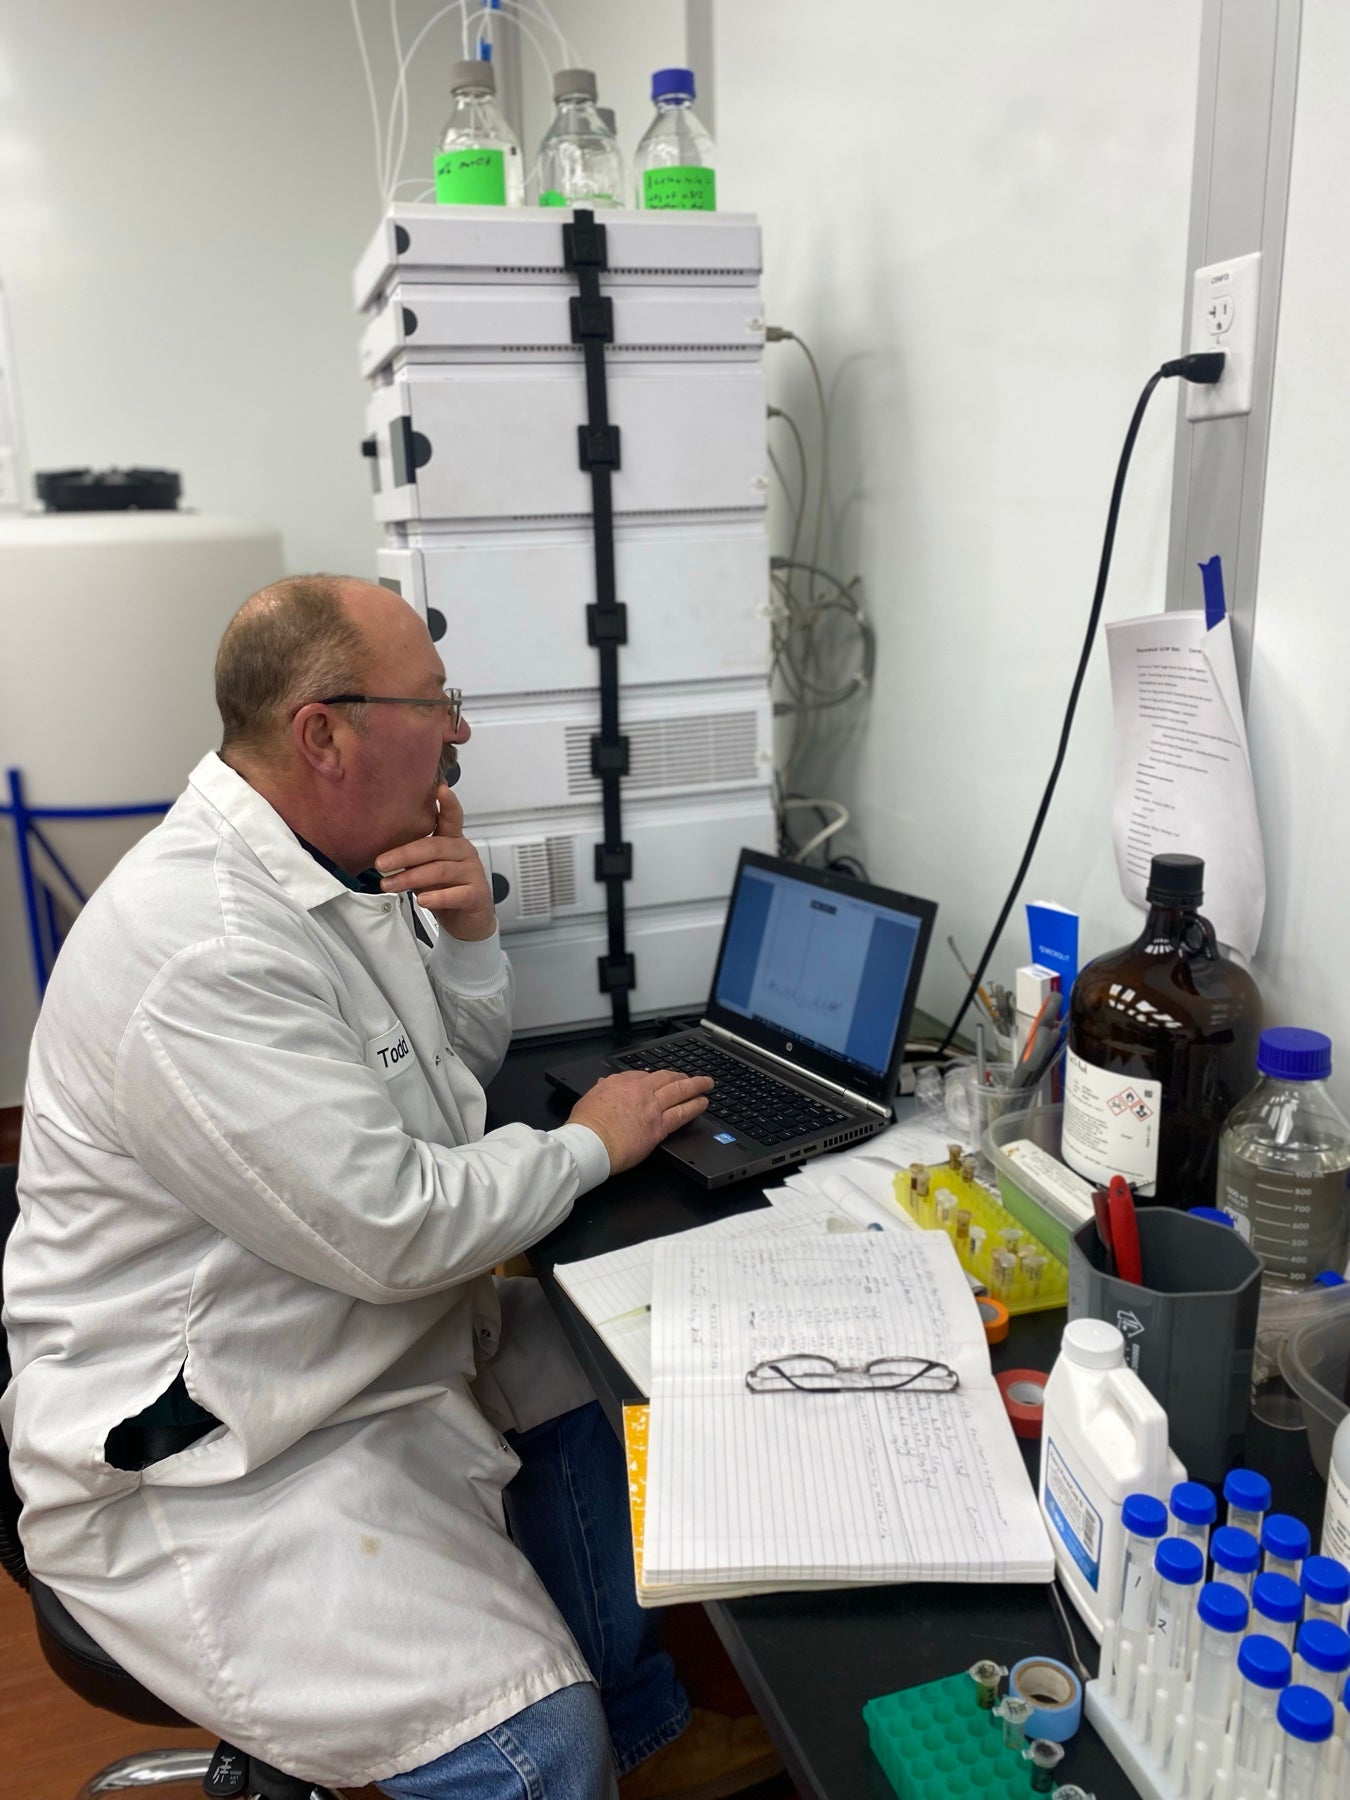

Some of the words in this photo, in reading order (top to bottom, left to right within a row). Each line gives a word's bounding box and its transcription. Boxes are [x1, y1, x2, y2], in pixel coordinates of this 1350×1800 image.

[377, 1035, 410, 1068] Todd
[1295, 1170, 1312, 1178] 900
[1294, 1205, 1311, 1213] 700
[1292, 1222, 1310, 1230] 600
[1291, 1239, 1309, 1247] 500
[1290, 1256, 1307, 1264] 400
[1289, 1272, 1306, 1280] 300
[1157, 1618, 1167, 1635] 2
